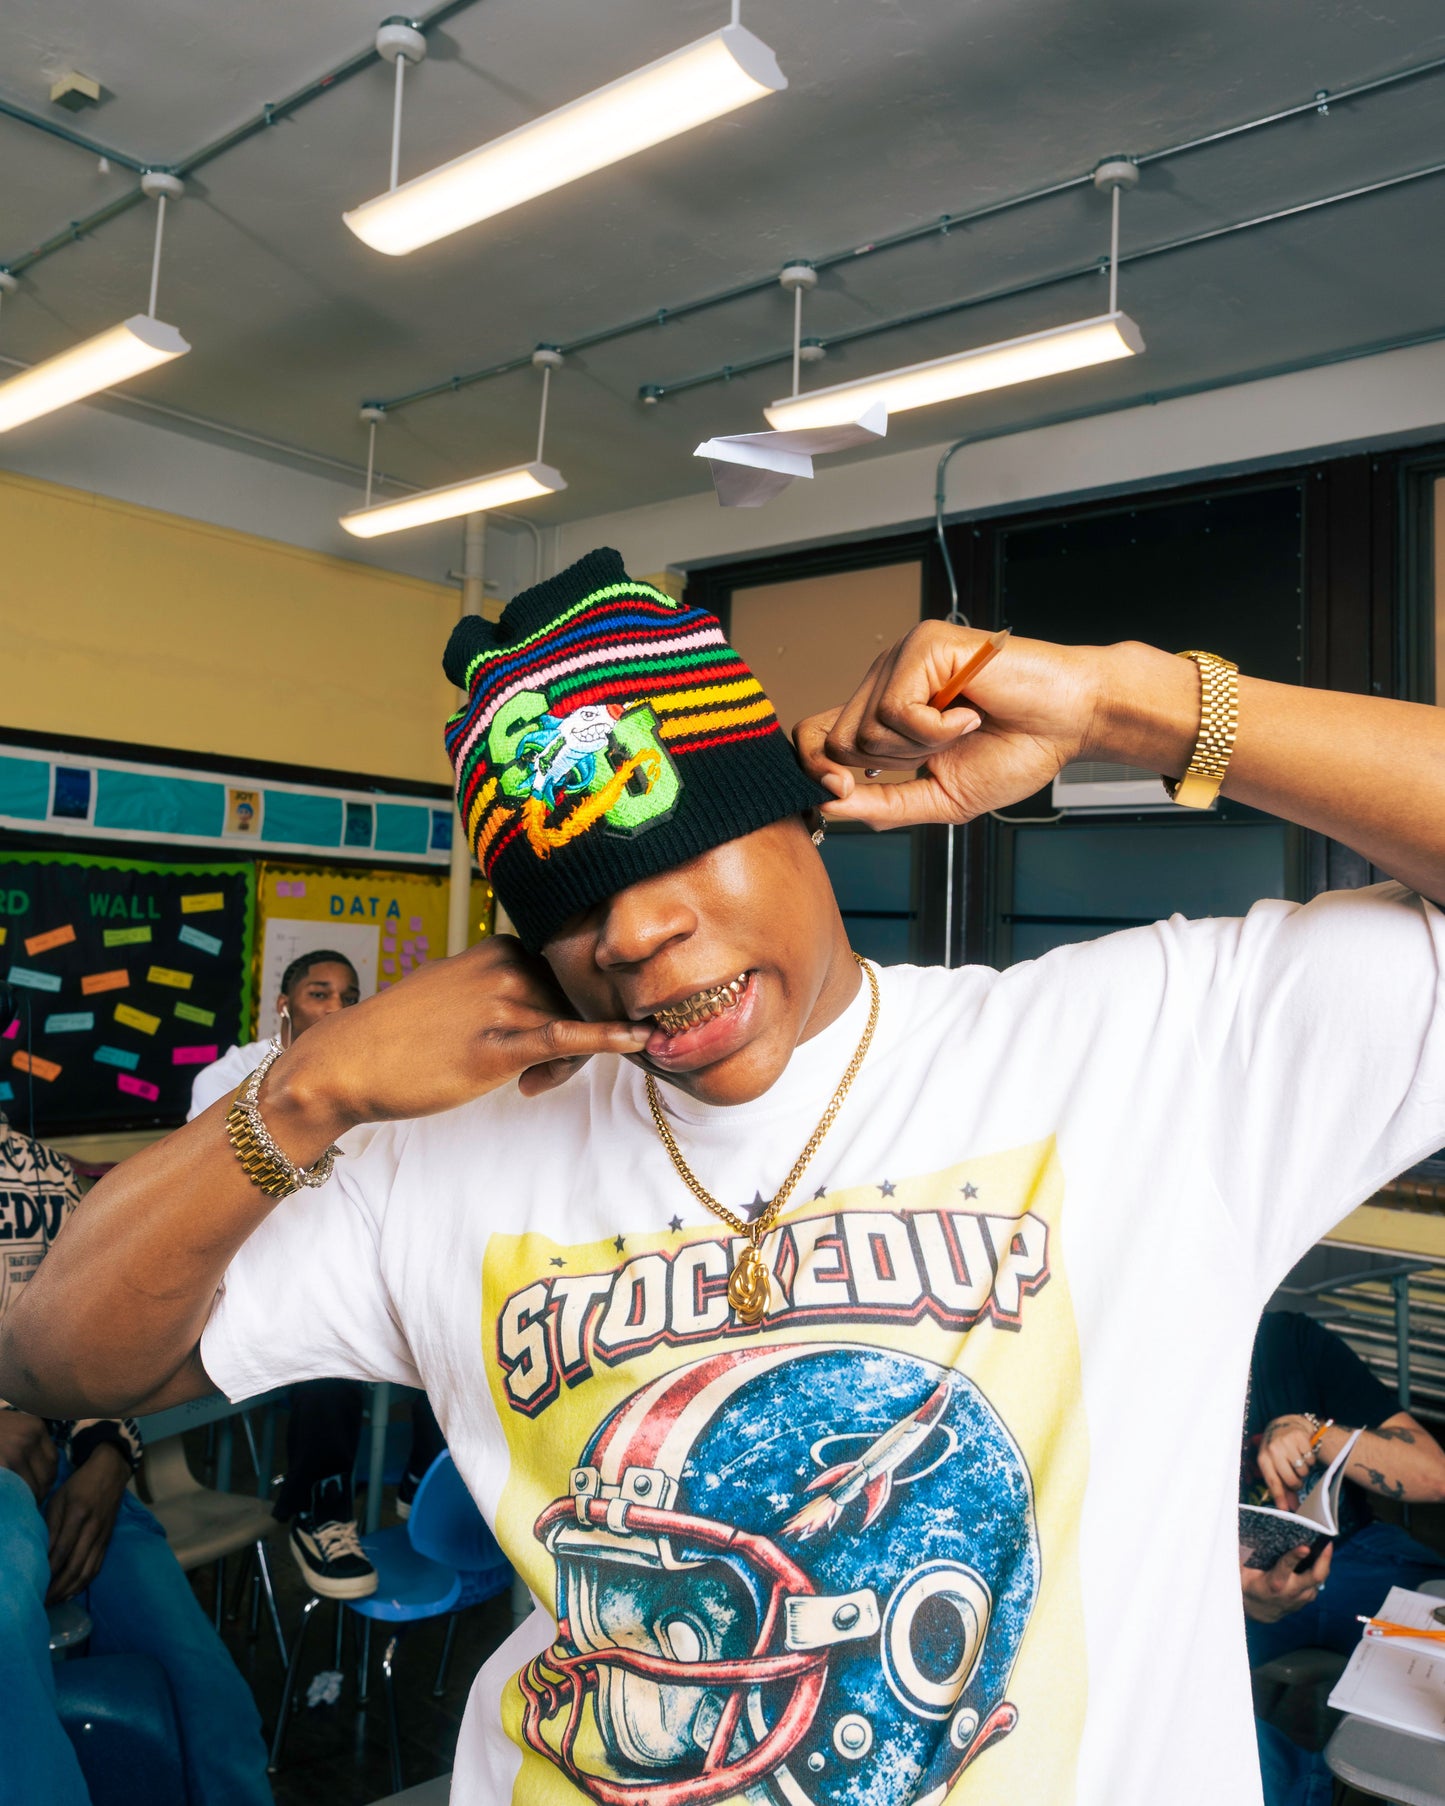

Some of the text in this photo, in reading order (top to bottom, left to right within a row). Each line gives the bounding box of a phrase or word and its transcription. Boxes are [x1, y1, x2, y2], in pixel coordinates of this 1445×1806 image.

[0, 889, 161, 919] D WALL
[329, 894, 401, 919] DATA
